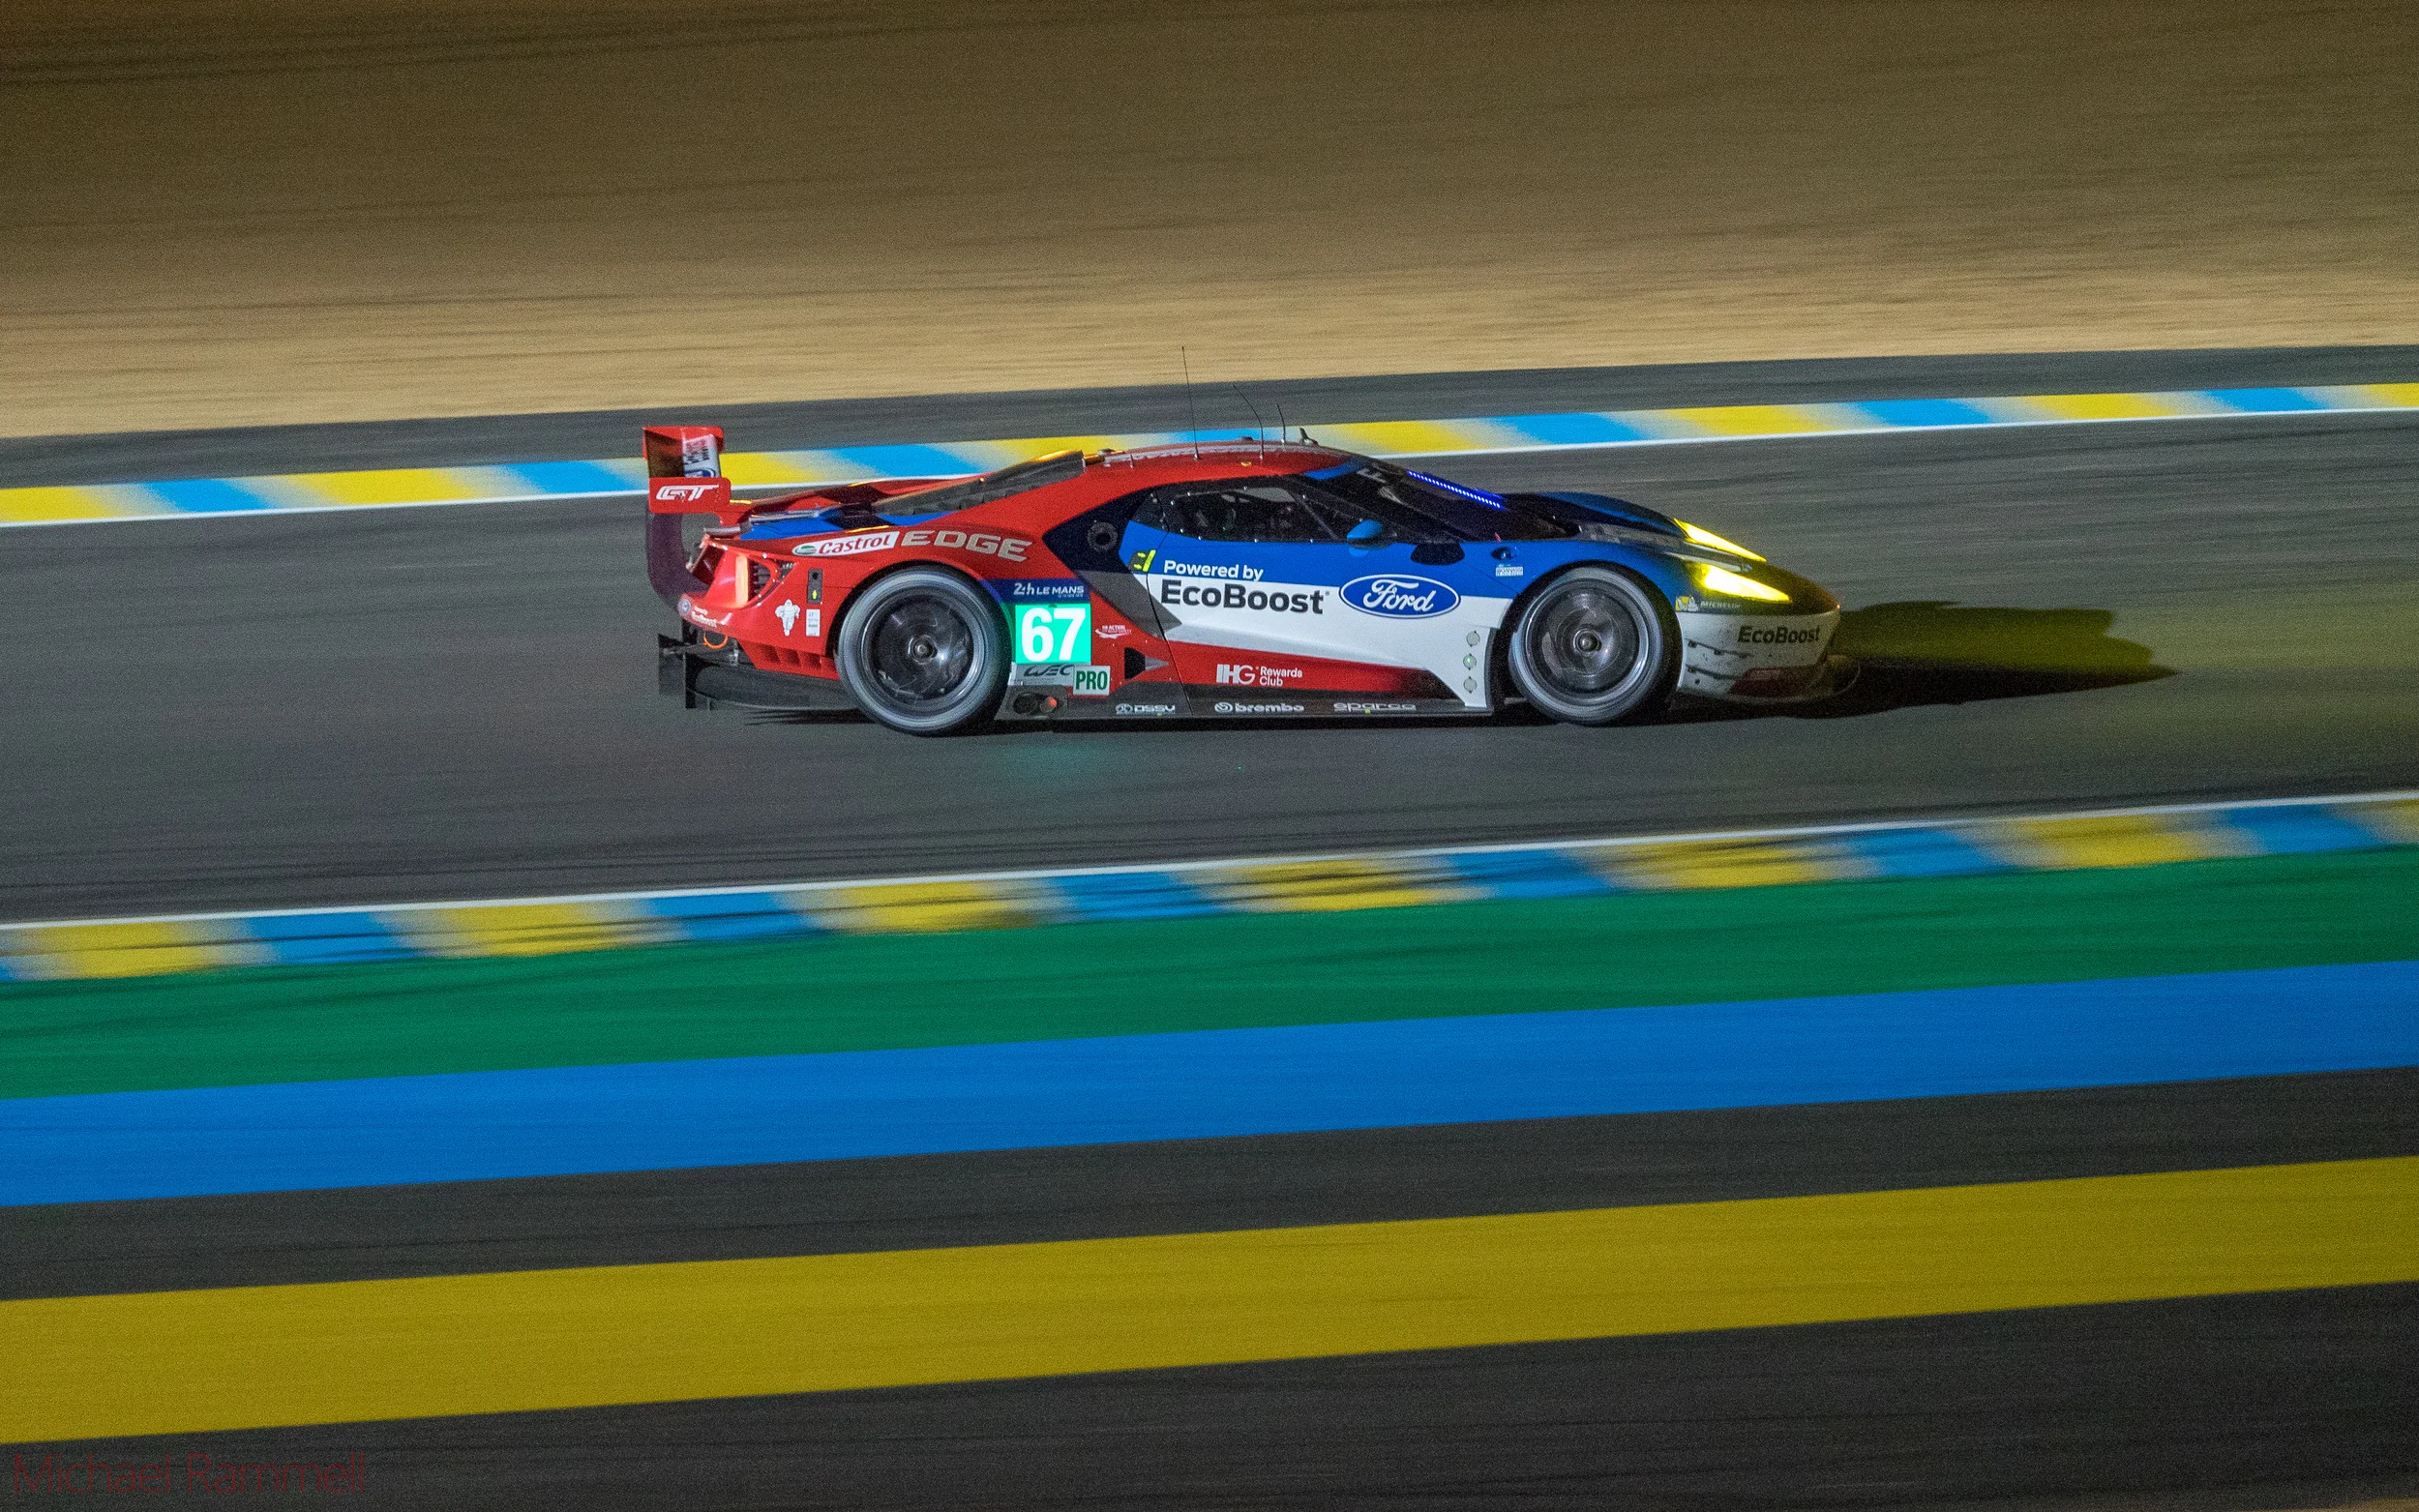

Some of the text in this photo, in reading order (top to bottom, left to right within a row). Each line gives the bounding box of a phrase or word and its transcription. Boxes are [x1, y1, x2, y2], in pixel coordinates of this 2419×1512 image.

[819, 530, 1033, 563] Castrol EDGE
[1163, 559, 1264, 581] Powered by
[1036, 586, 1050, 595] LE
[1052, 585, 1084, 595] MANS
[1161, 578, 1324, 615] EcoBoost
[1362, 578, 1437, 612] Ford
[1021, 607, 1087, 663] 67
[1738, 625, 1820, 644] EcoBoost
[1023, 665, 1075, 677] WEC
[1075, 670, 1108, 691] PRO
[1216, 664, 1256, 685] IHG
[1260, 666, 1302, 678] Rewards
[1259, 676, 1284, 687] Club
[1235, 703, 1304, 713] brembo
[1333, 702, 1417, 712] sparco
